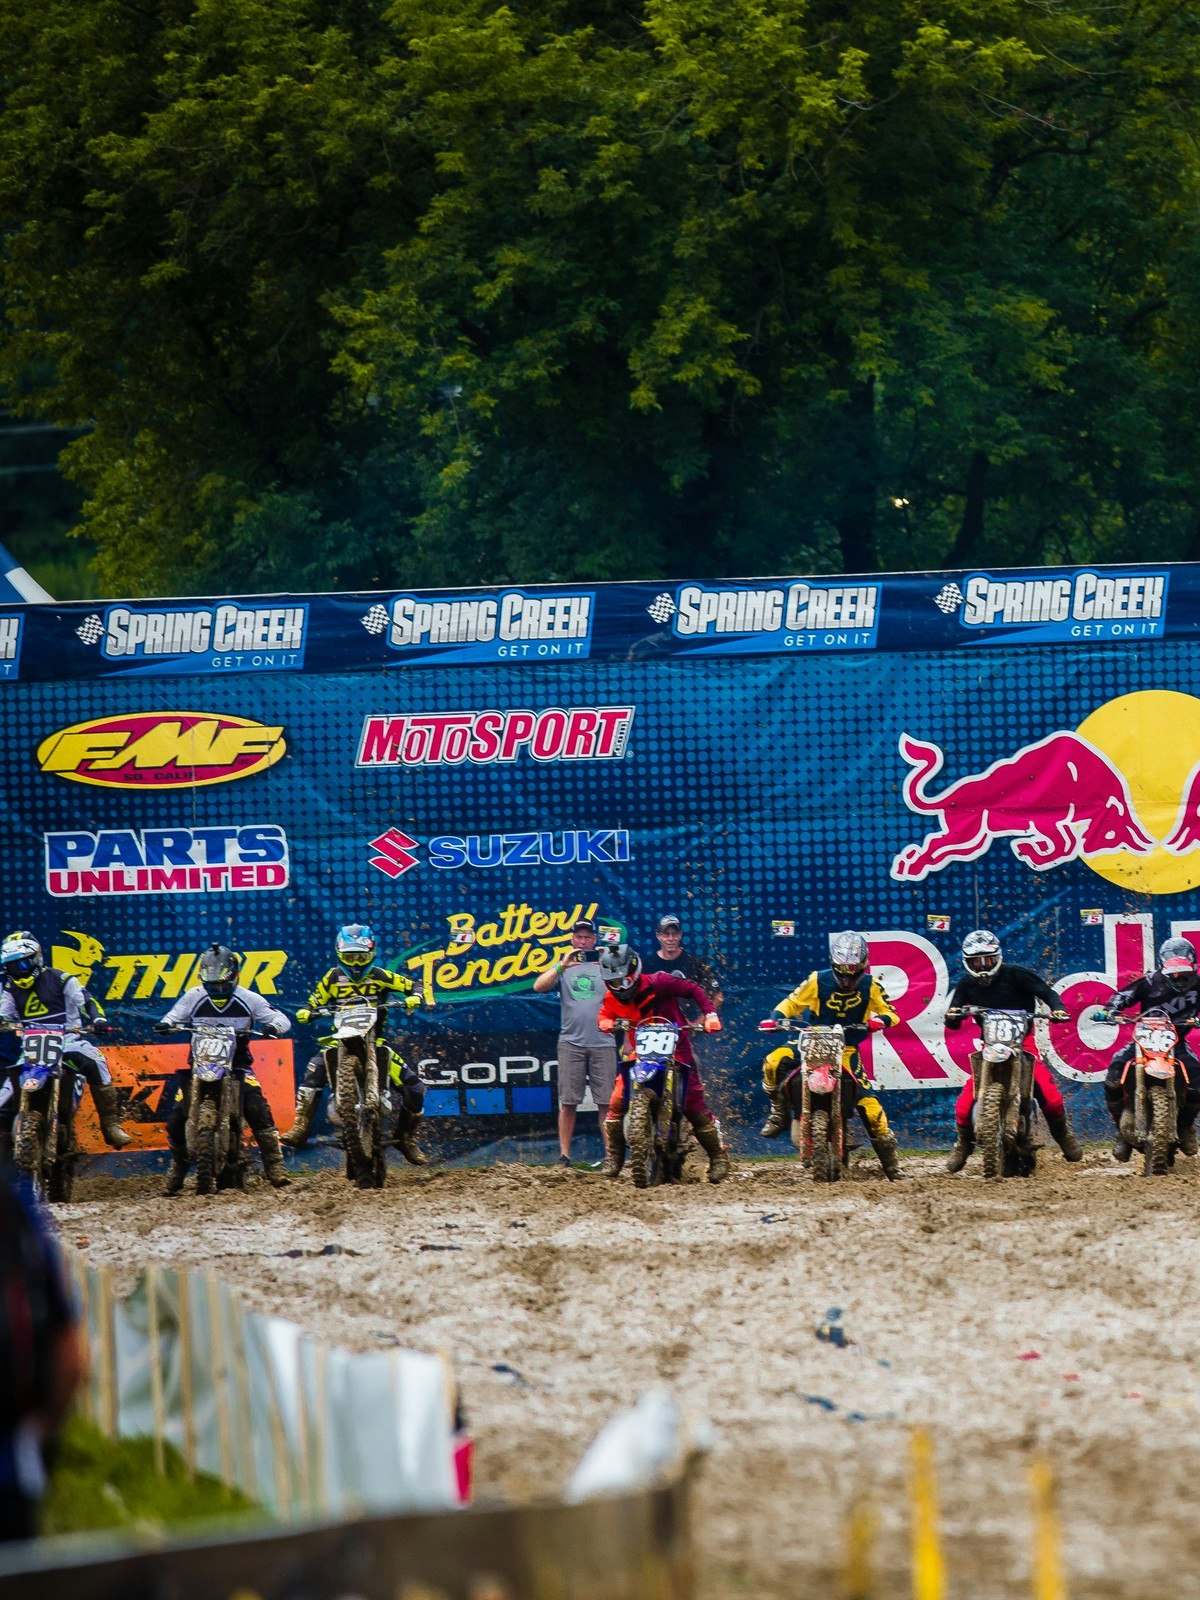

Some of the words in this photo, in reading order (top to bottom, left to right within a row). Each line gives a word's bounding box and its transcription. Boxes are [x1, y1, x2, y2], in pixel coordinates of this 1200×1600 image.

[677, 586, 785, 635] SPRING
[785, 583, 877, 631] CREEK
[963, 577, 1072, 625] SPRING
[1072, 573, 1164, 621] CREEK
[105, 608, 213, 656] SPRING
[213, 605, 305, 652] CREEK
[390, 598, 498, 646] SPRING
[499, 593, 591, 642] CREEK
[1071, 624, 1104, 637] GET
[1111, 623, 1135, 635] ON
[1141, 623, 1158, 634] IT
[498, 645, 531, 657] GET
[538, 644, 560, 655] ON
[567, 643, 584, 654] IT
[784, 634, 817, 647] GET
[824, 633, 848, 645] ON
[854, 633, 871, 644] IT
[212, 656, 244, 668] GET
[252, 655, 274, 667] ON
[282, 654, 298, 665] IT
[40, 720, 285, 771] FMF
[49, 827, 286, 869] PARTS
[429, 830, 630, 869] SUZUKI
[49, 864, 286, 895] UNLIMITED
[829, 913, 1154, 1090] Rd
[25, 1035, 63, 1065] 96
[636, 1032, 679, 1055] 38
[417, 1055, 559, 1085] GoPr
